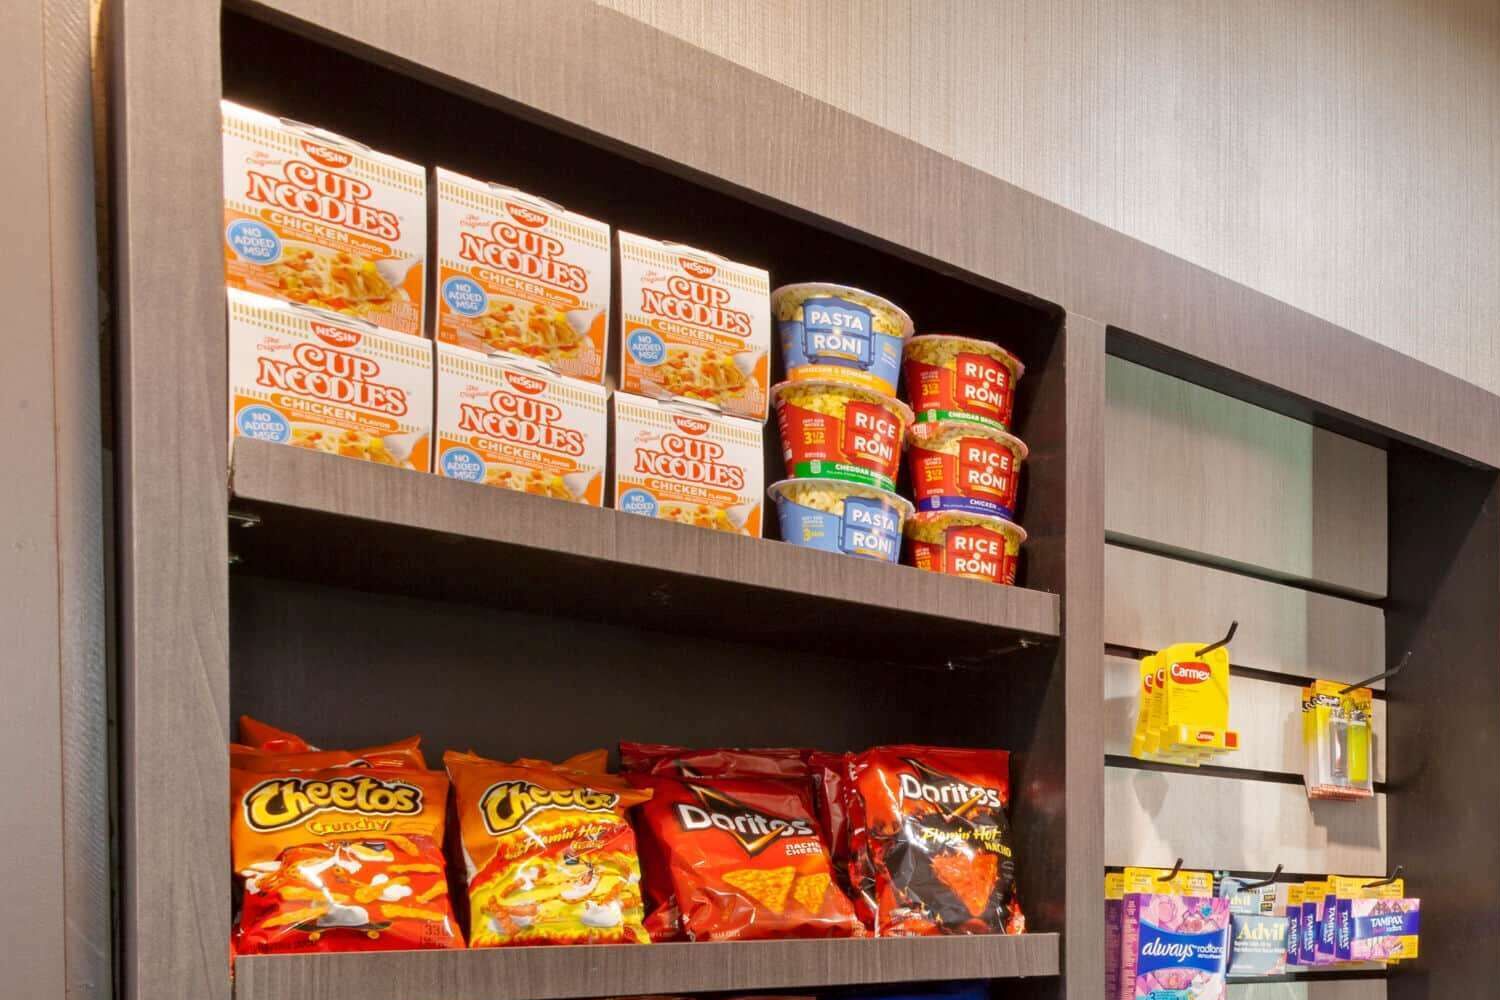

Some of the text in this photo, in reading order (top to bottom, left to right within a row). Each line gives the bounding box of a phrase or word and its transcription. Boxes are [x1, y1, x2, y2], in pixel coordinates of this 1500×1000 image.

[305, 144, 348, 165] NISSIN
[284, 160, 372, 201] CUP
[246, 171, 400, 241] NOODLES
[242, 227, 261, 238] NO
[271, 210, 349, 242] CHICKEN
[235, 236, 275, 249] ADDED
[491, 221, 564, 257] CUP
[459, 232, 588, 293] NOODLES
[456, 283, 471, 292] NO
[479, 270, 544, 295] CHICKEN
[668, 276, 731, 305] CUP
[449, 291, 482, 301] ADDED
[641, 288, 752, 337] NOODLES
[811, 311, 863, 331] PASTA
[316, 325, 358, 344] NISSIN
[638, 335, 652, 343] NO
[658, 322, 714, 342] CHICKEN
[632, 343, 661, 352] ADDED
[814, 335, 861, 354] RONI
[293, 343, 380, 381] CUP
[965, 362, 1005, 386] RICE
[256, 357, 408, 417] NOODLES
[964, 384, 1003, 407] RONI
[252, 413, 271, 422] NO
[280, 396, 357, 422] CHICKEN
[490, 390, 562, 424] CUP
[244, 421, 284, 432] ADDED
[458, 403, 585, 457] NOODLES
[855, 412, 896, 438] RICE
[478, 439, 541, 461] CHICKEN
[661, 433, 723, 462] CUP
[854, 435, 893, 460] RONI
[448, 462, 480, 471] ADDED
[634, 448, 744, 490] NOODLES
[968, 448, 1009, 470] RICE
[651, 480, 708, 498] CHICKEN
[968, 469, 1007, 490] RONI
[625, 503, 654, 511] ADDED
[852, 510, 895, 530] PASTA
[853, 533, 892, 554] RONI
[955, 536, 998, 555] RICE
[955, 558, 997, 576] RONI
[1171, 663, 1211, 680] Carmex
[900, 773, 1001, 808] Doritos
[247, 776, 419, 829] Cheetos
[677, 804, 814, 837] Doritos
[1238, 922, 1285, 941] Advil
[1370, 915, 1404, 929] TAMPAX
[1142, 937, 1194, 962] always
